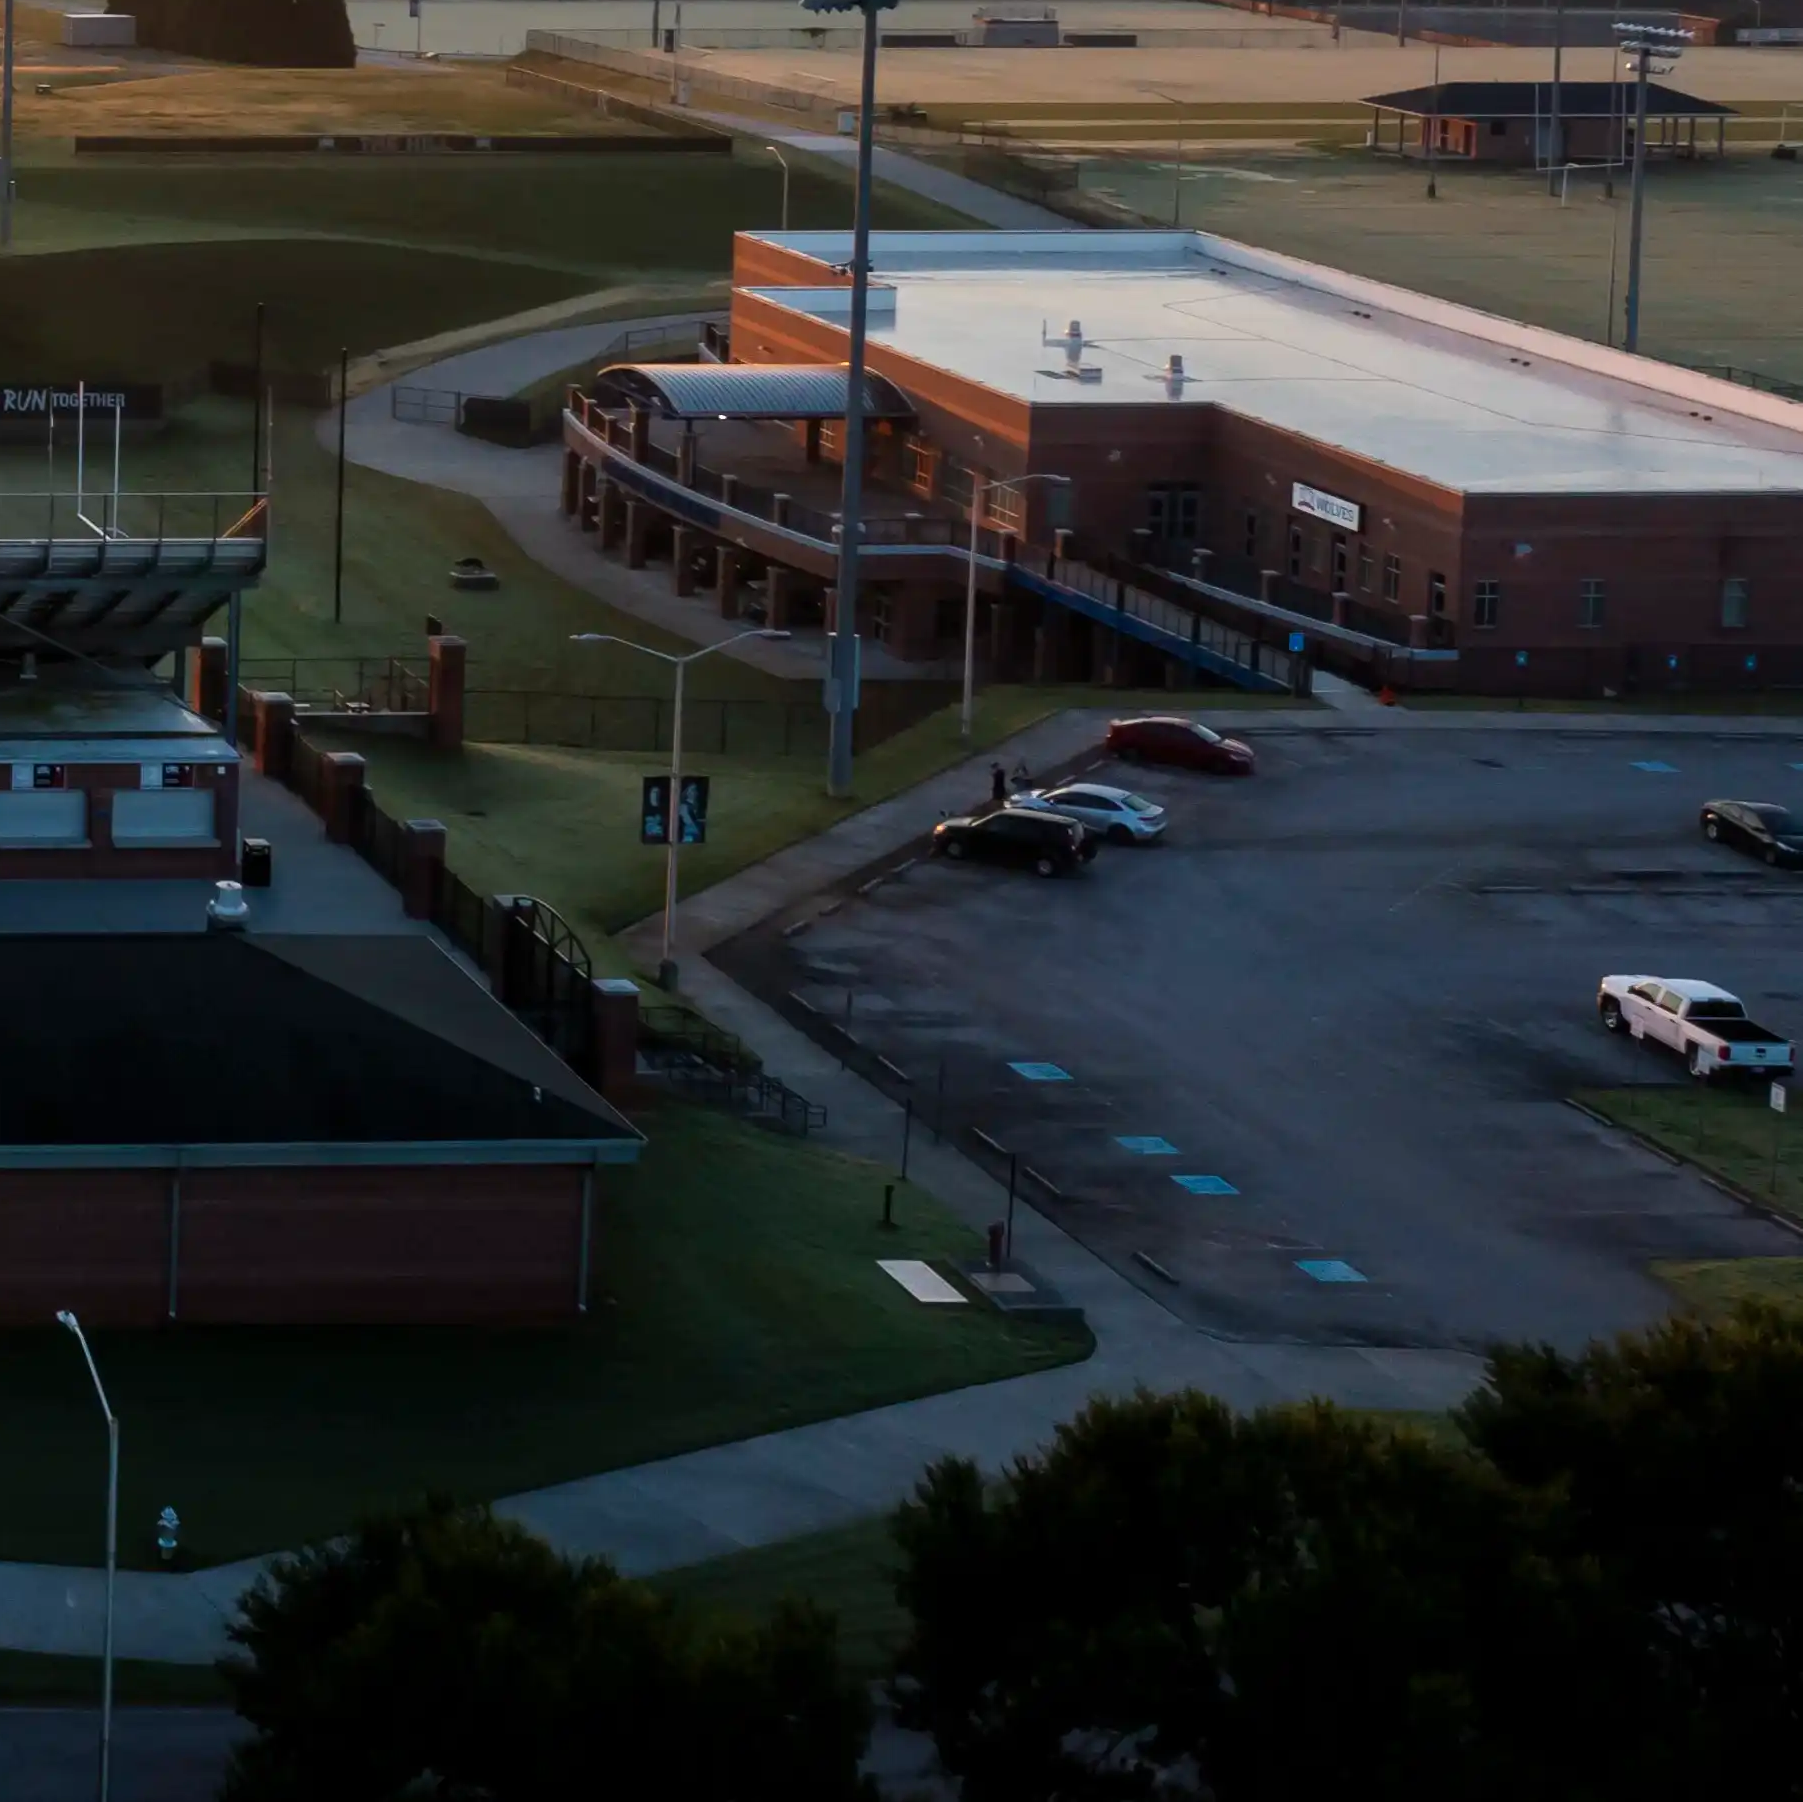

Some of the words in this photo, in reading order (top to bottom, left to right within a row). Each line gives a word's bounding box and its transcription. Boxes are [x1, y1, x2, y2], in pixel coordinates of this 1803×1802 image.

[3, 388, 47, 411] RUN
[51, 392, 125, 407] TOGETHER
[1317, 497, 1354, 522] WOLVES
